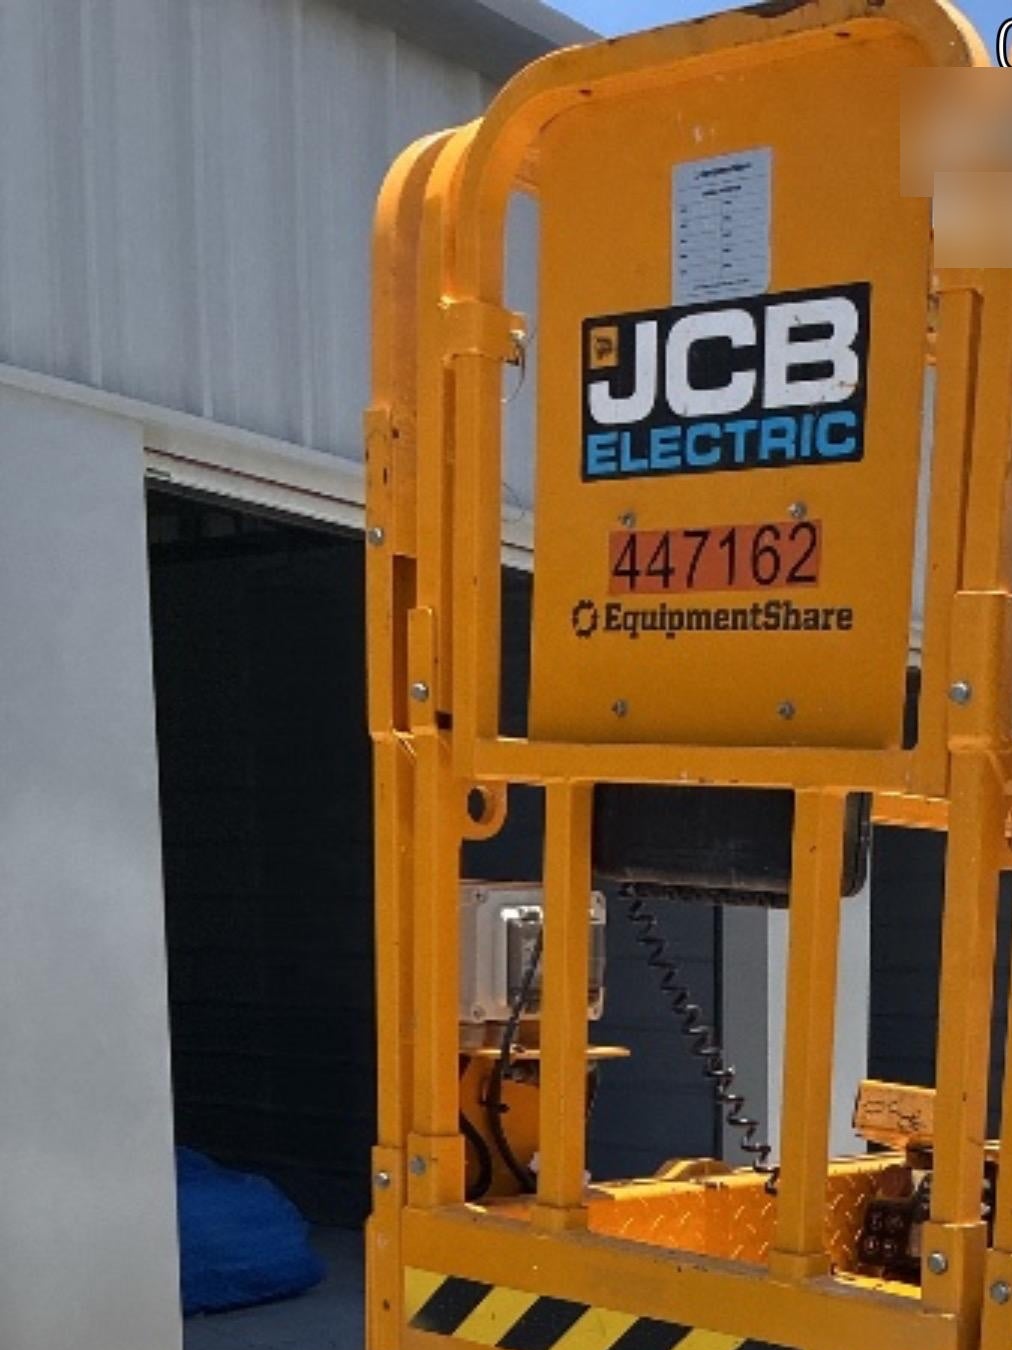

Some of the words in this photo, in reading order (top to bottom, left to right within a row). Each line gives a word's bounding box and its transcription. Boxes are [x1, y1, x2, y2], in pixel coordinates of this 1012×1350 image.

[587, 297, 860, 424] JCB
[587, 410, 857, 475] ELECTRIC
[612, 522, 817, 588] 447162
[603, 601, 853, 638] EquipmentShare
